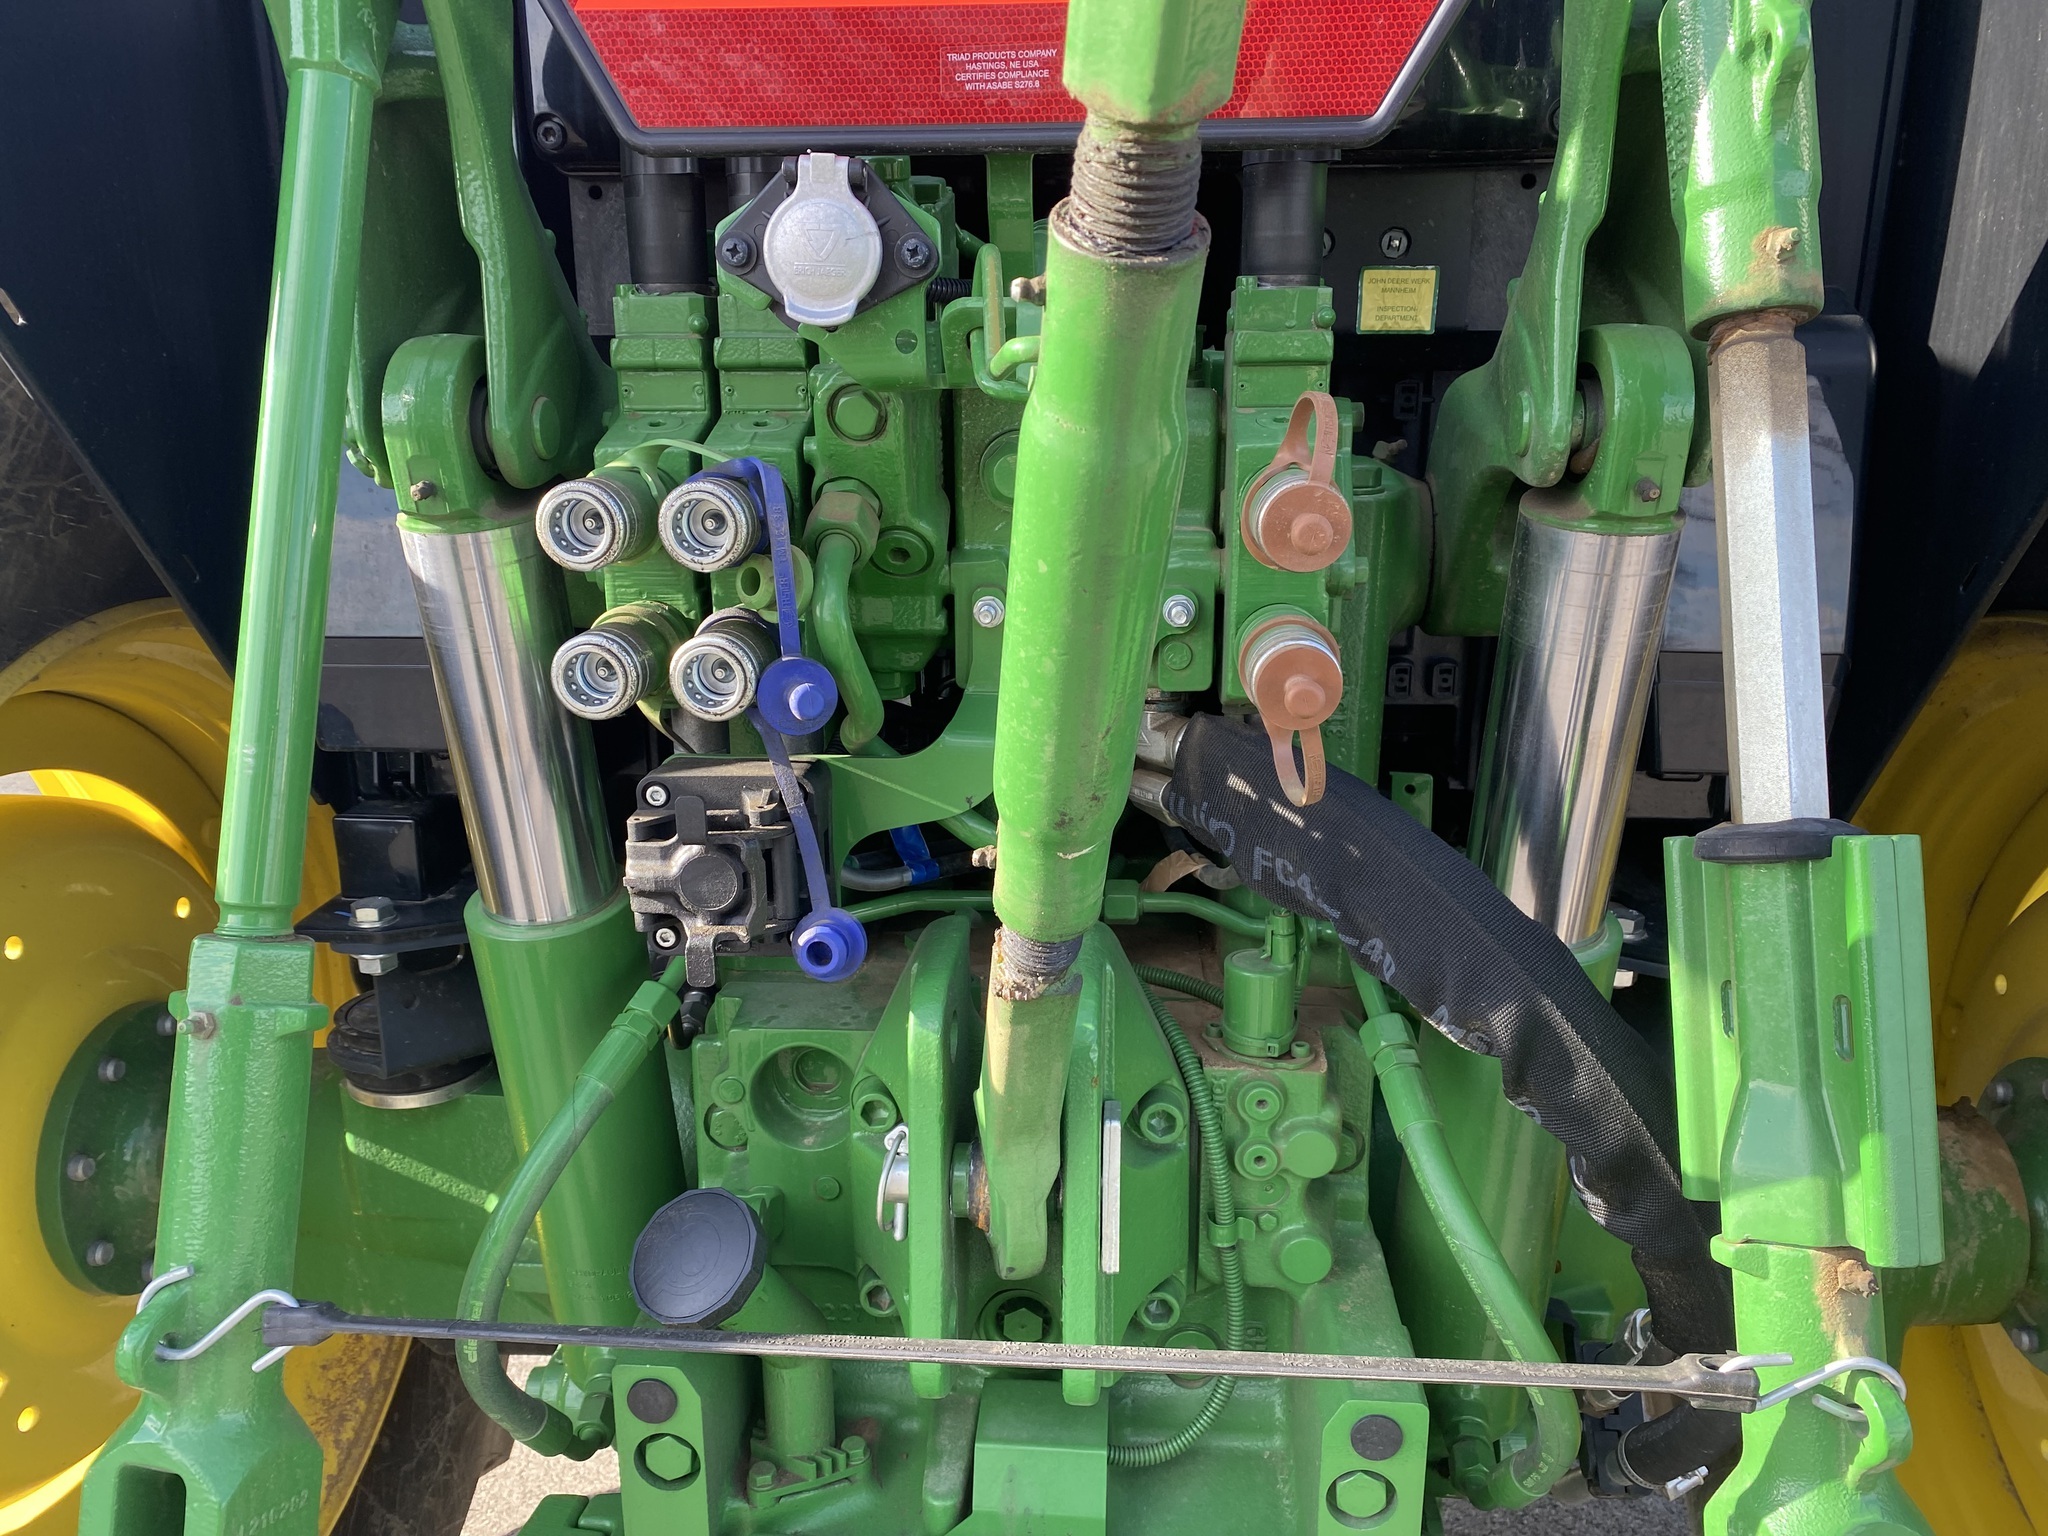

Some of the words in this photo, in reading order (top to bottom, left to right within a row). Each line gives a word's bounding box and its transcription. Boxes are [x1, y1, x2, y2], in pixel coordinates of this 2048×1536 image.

[947, 53, 971, 61] TRIAD
[972, 50, 1017, 60] PRODUCTS
[1018, 49, 1058, 58] COMPANY
[965, 61, 1008, 70] HASTINGS,
[1009, 61, 1021, 69] NE
[1022, 60, 1039, 68] USA
[955, 71, 996, 81] CERTIFIES
[997, 69, 1050, 79] COMPLIANCE
[965, 82, 986, 90] WITH
[986, 81, 1013, 89] ASABE
[1014, 80, 1040, 89] S276.8
[1410, 277, 1431, 285] WERK
[1375, 314, 1418, 322] DEPARTMENT
